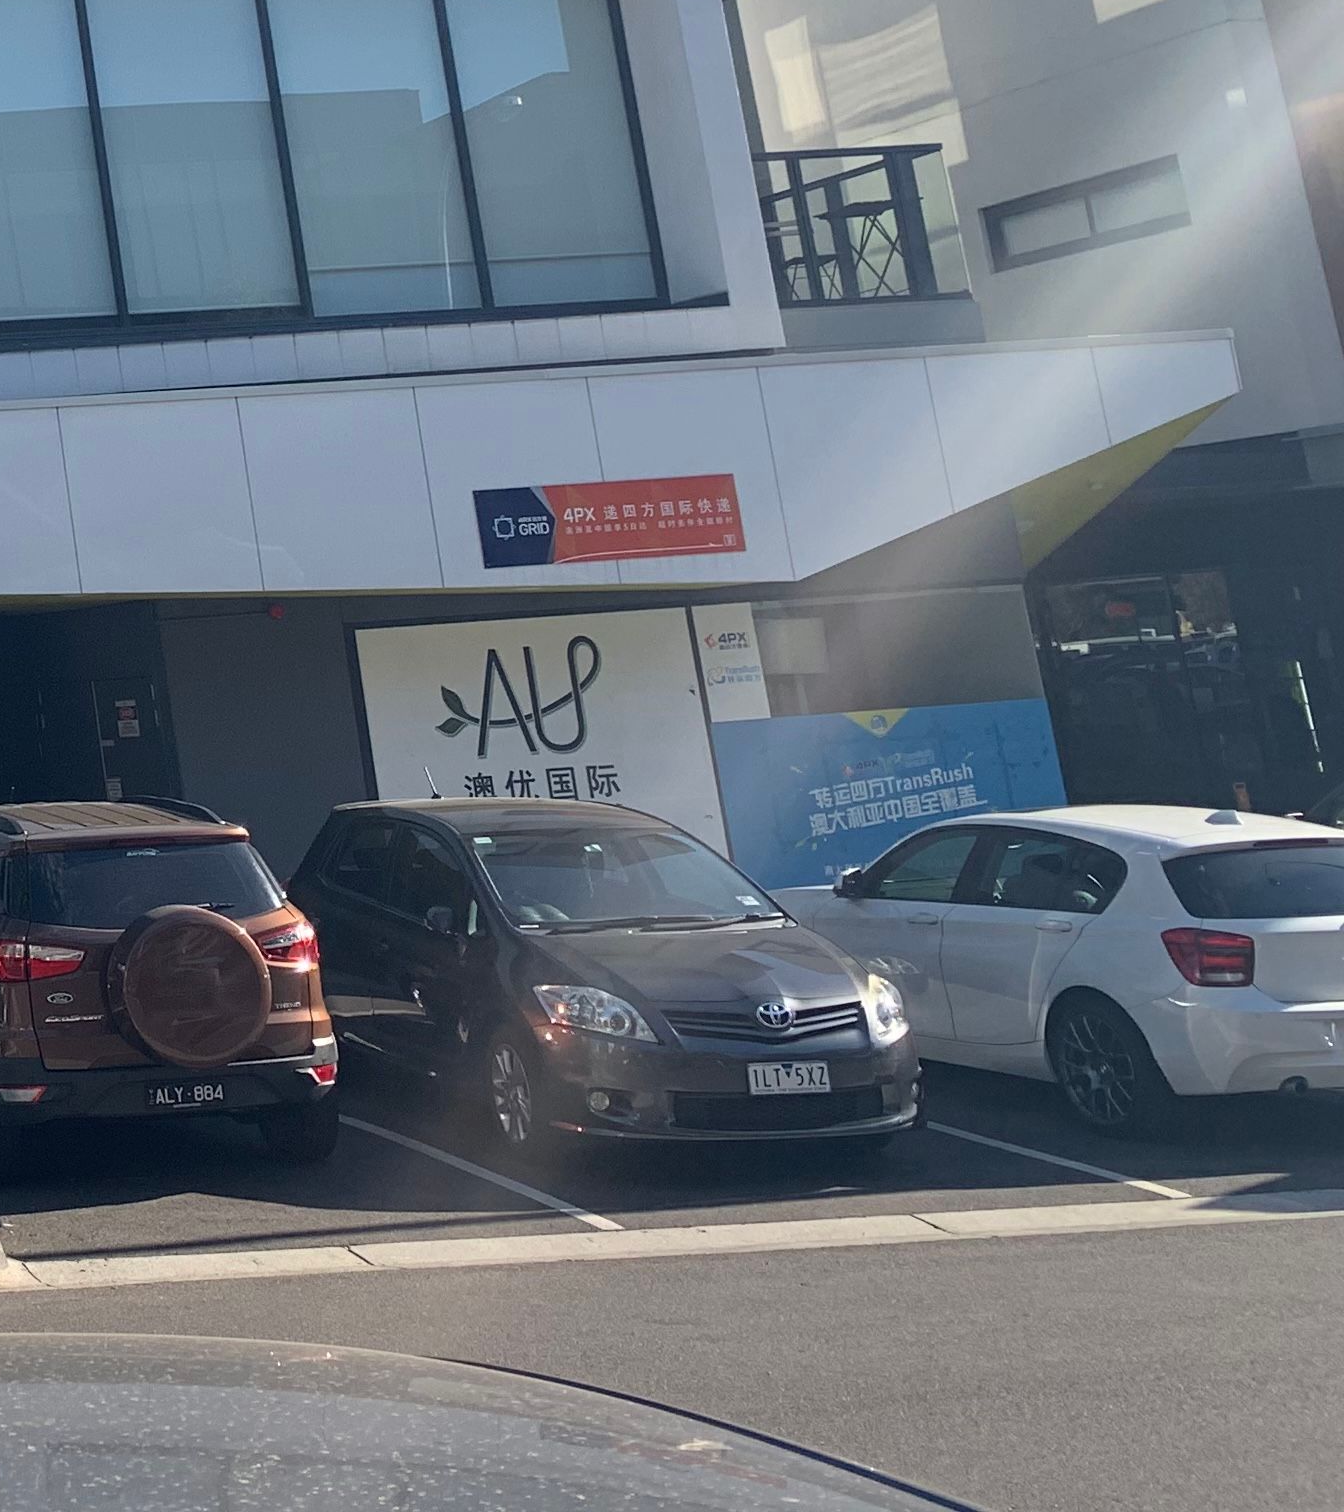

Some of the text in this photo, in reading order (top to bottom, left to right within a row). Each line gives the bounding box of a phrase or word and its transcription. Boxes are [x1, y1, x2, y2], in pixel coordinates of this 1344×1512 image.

[563, 507, 597, 524] 4PX
[518, 522, 550, 536] GRID
[718, 632, 747, 643] 4PX
[464, 765, 621, 800] 澳优国际
[808, 763, 974, 809] 转运四方TransRush
[808, 784, 988, 836] 澳大利亚中国全覆盖
[753, 1066, 827, 1088] 1LT 5XZ
